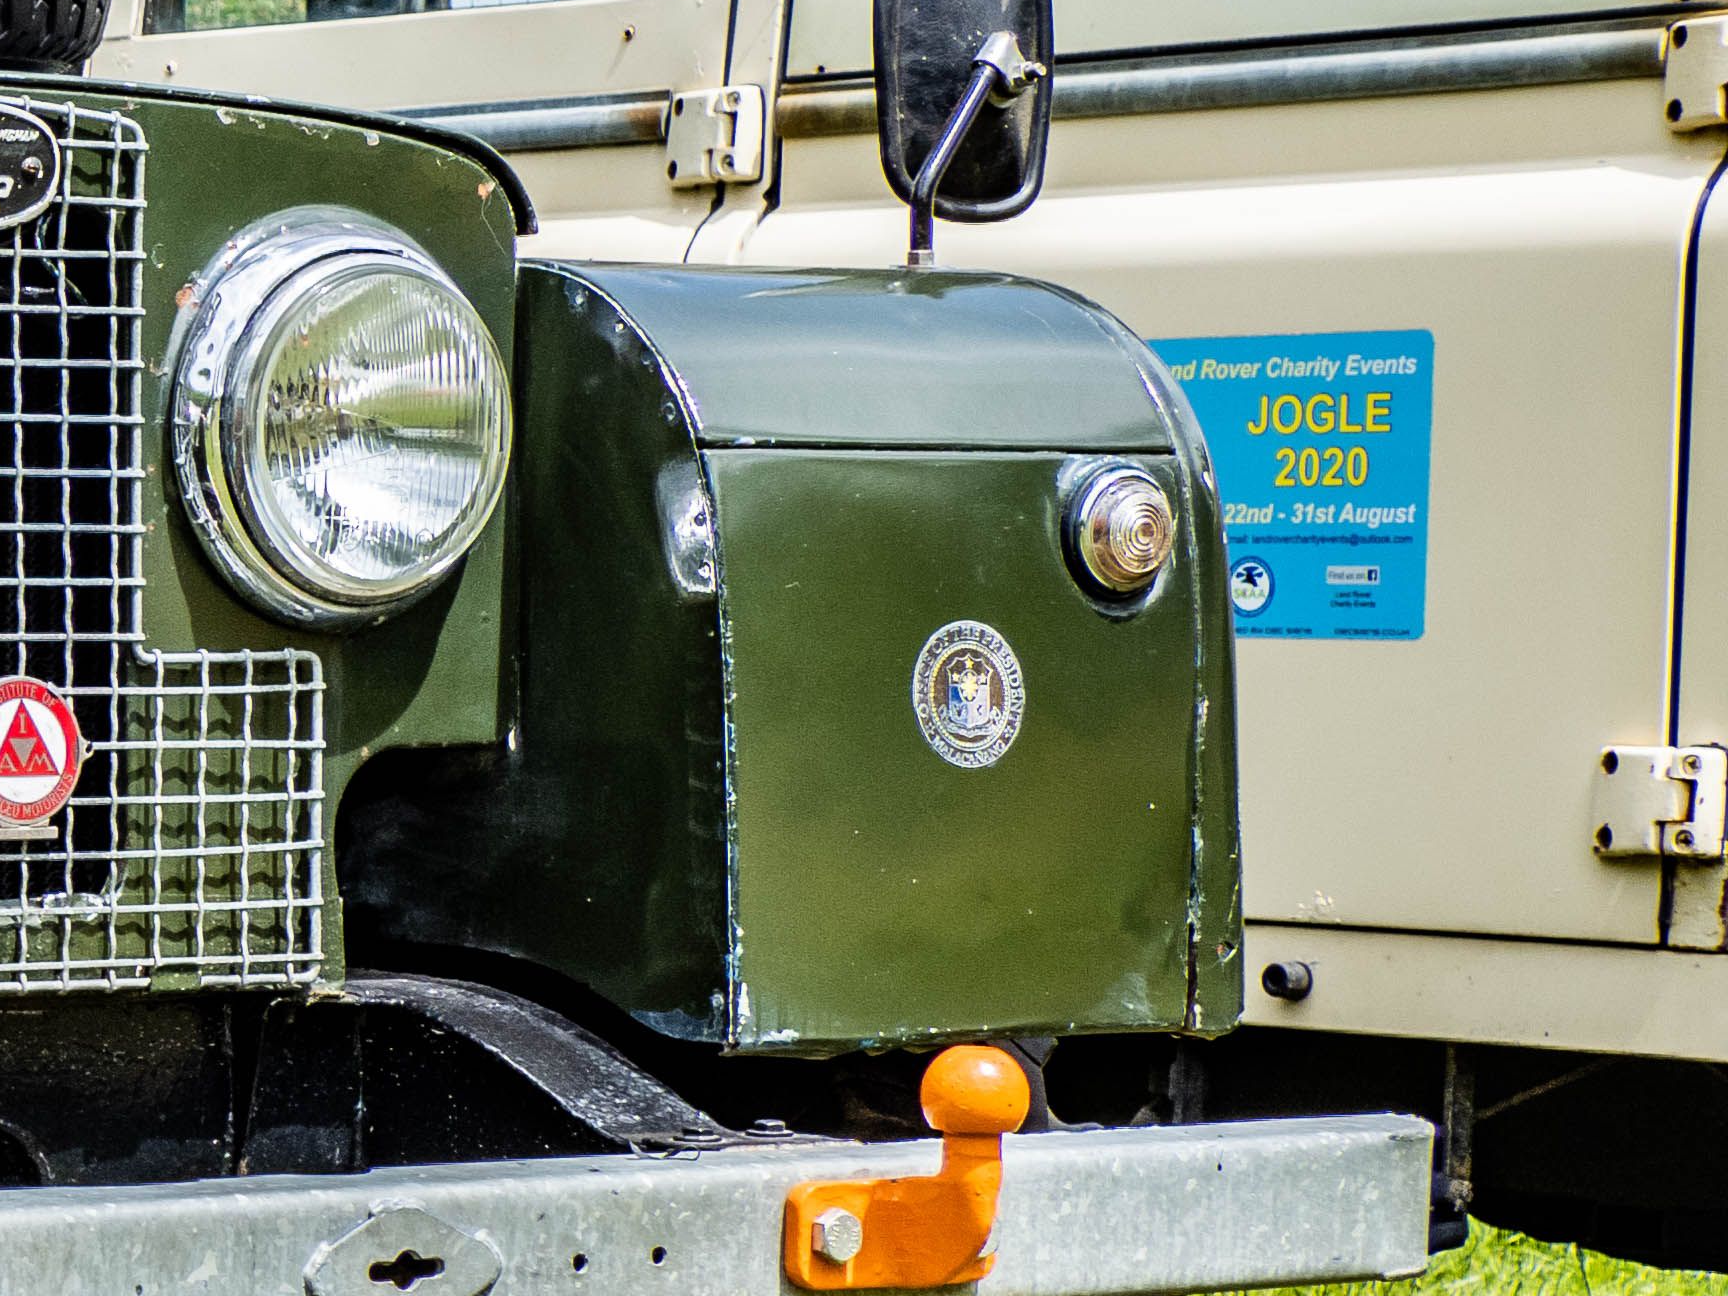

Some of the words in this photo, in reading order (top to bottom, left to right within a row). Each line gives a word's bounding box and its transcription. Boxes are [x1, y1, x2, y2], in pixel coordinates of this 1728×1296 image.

[1169, 360, 1195, 381] nd
[1200, 359, 1261, 380] Rover
[1266, 357, 1340, 382] Charity
[1345, 355, 1417, 376] Events
[1247, 392, 1392, 436] JOGLE
[1274, 447, 1369, 487] 2020
[1291, 504, 1335, 523] 31st
[1339, 503, 1416, 528] August
[42, 694, 60, 708] OF
[23, 773, 74, 817] MOTORISTS
